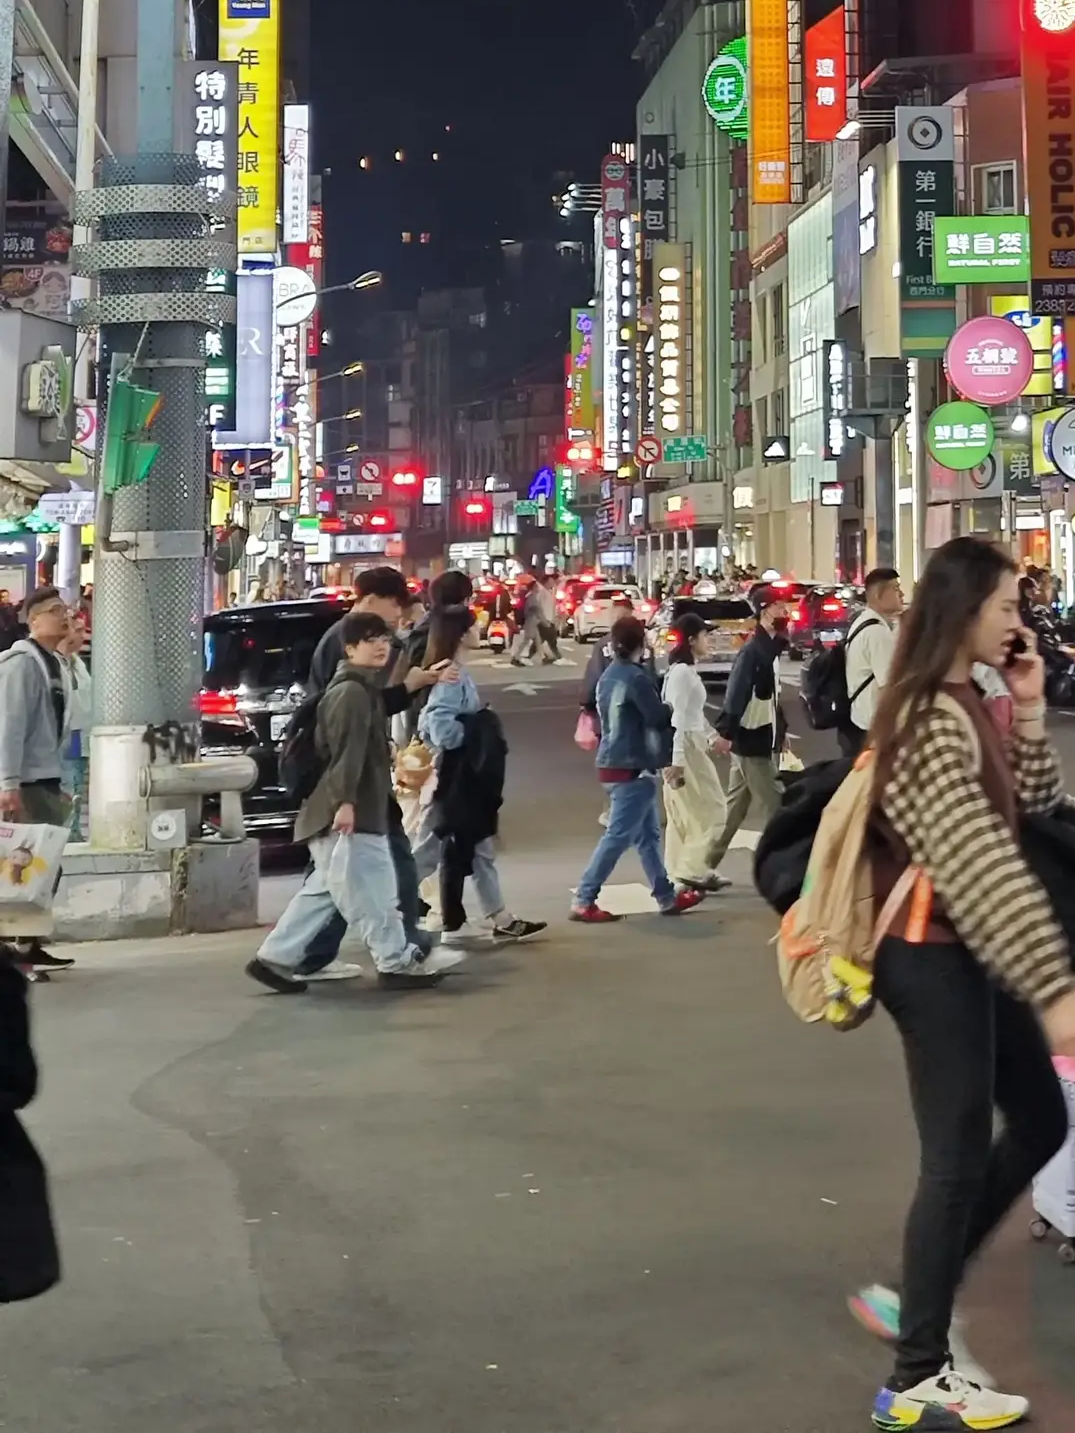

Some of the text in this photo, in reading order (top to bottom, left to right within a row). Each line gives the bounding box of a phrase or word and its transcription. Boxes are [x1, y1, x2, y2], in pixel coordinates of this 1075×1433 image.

[915, 170, 936, 258] 第一銀行
[1048, 133, 1075, 238] HOLIC
[28, 269, 41, 279] 4F
[1009, 452, 1030, 480] 第
